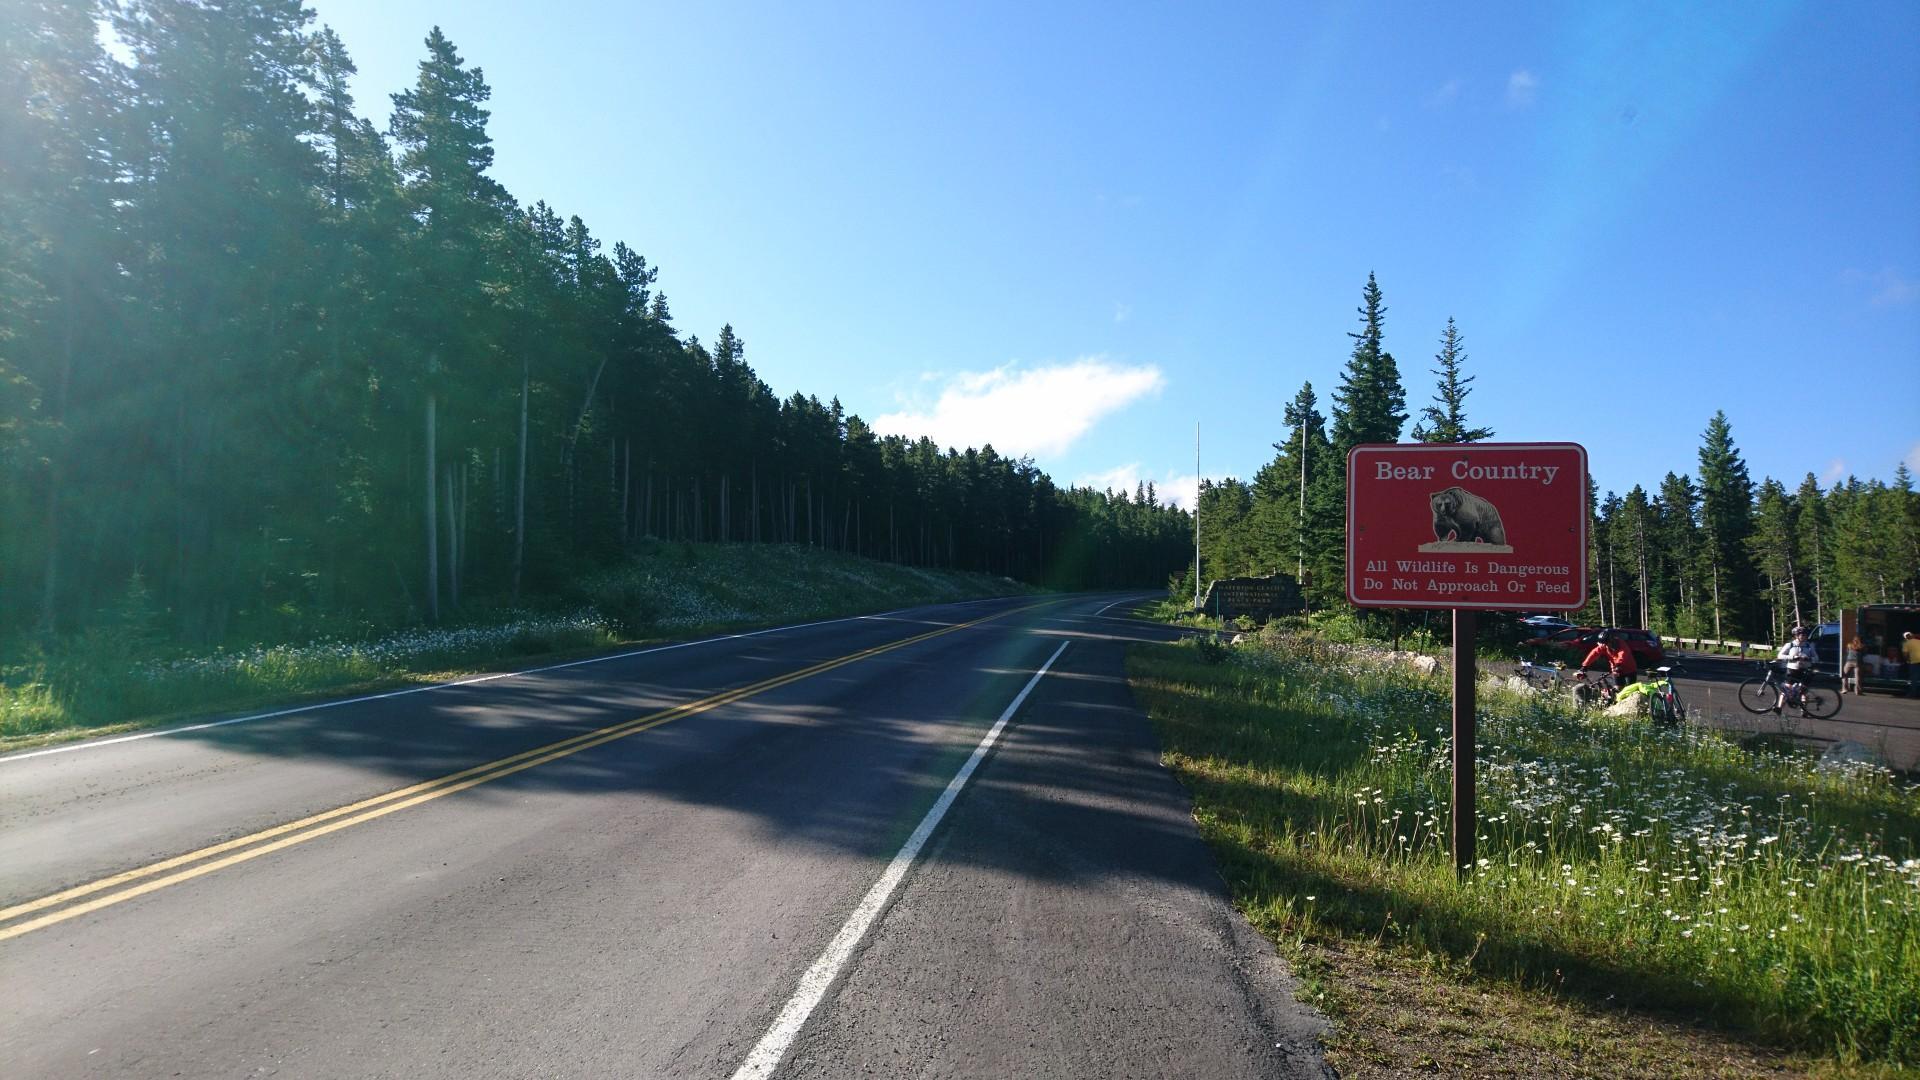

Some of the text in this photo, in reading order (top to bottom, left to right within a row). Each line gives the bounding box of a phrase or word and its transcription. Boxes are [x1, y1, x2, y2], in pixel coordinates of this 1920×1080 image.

[1375, 460, 1560, 485] Bear Country
[1365, 560, 1569, 577] All Wildlife Is Dangerous
[1363, 577, 1570, 594] Do Not Approach Or Feed
